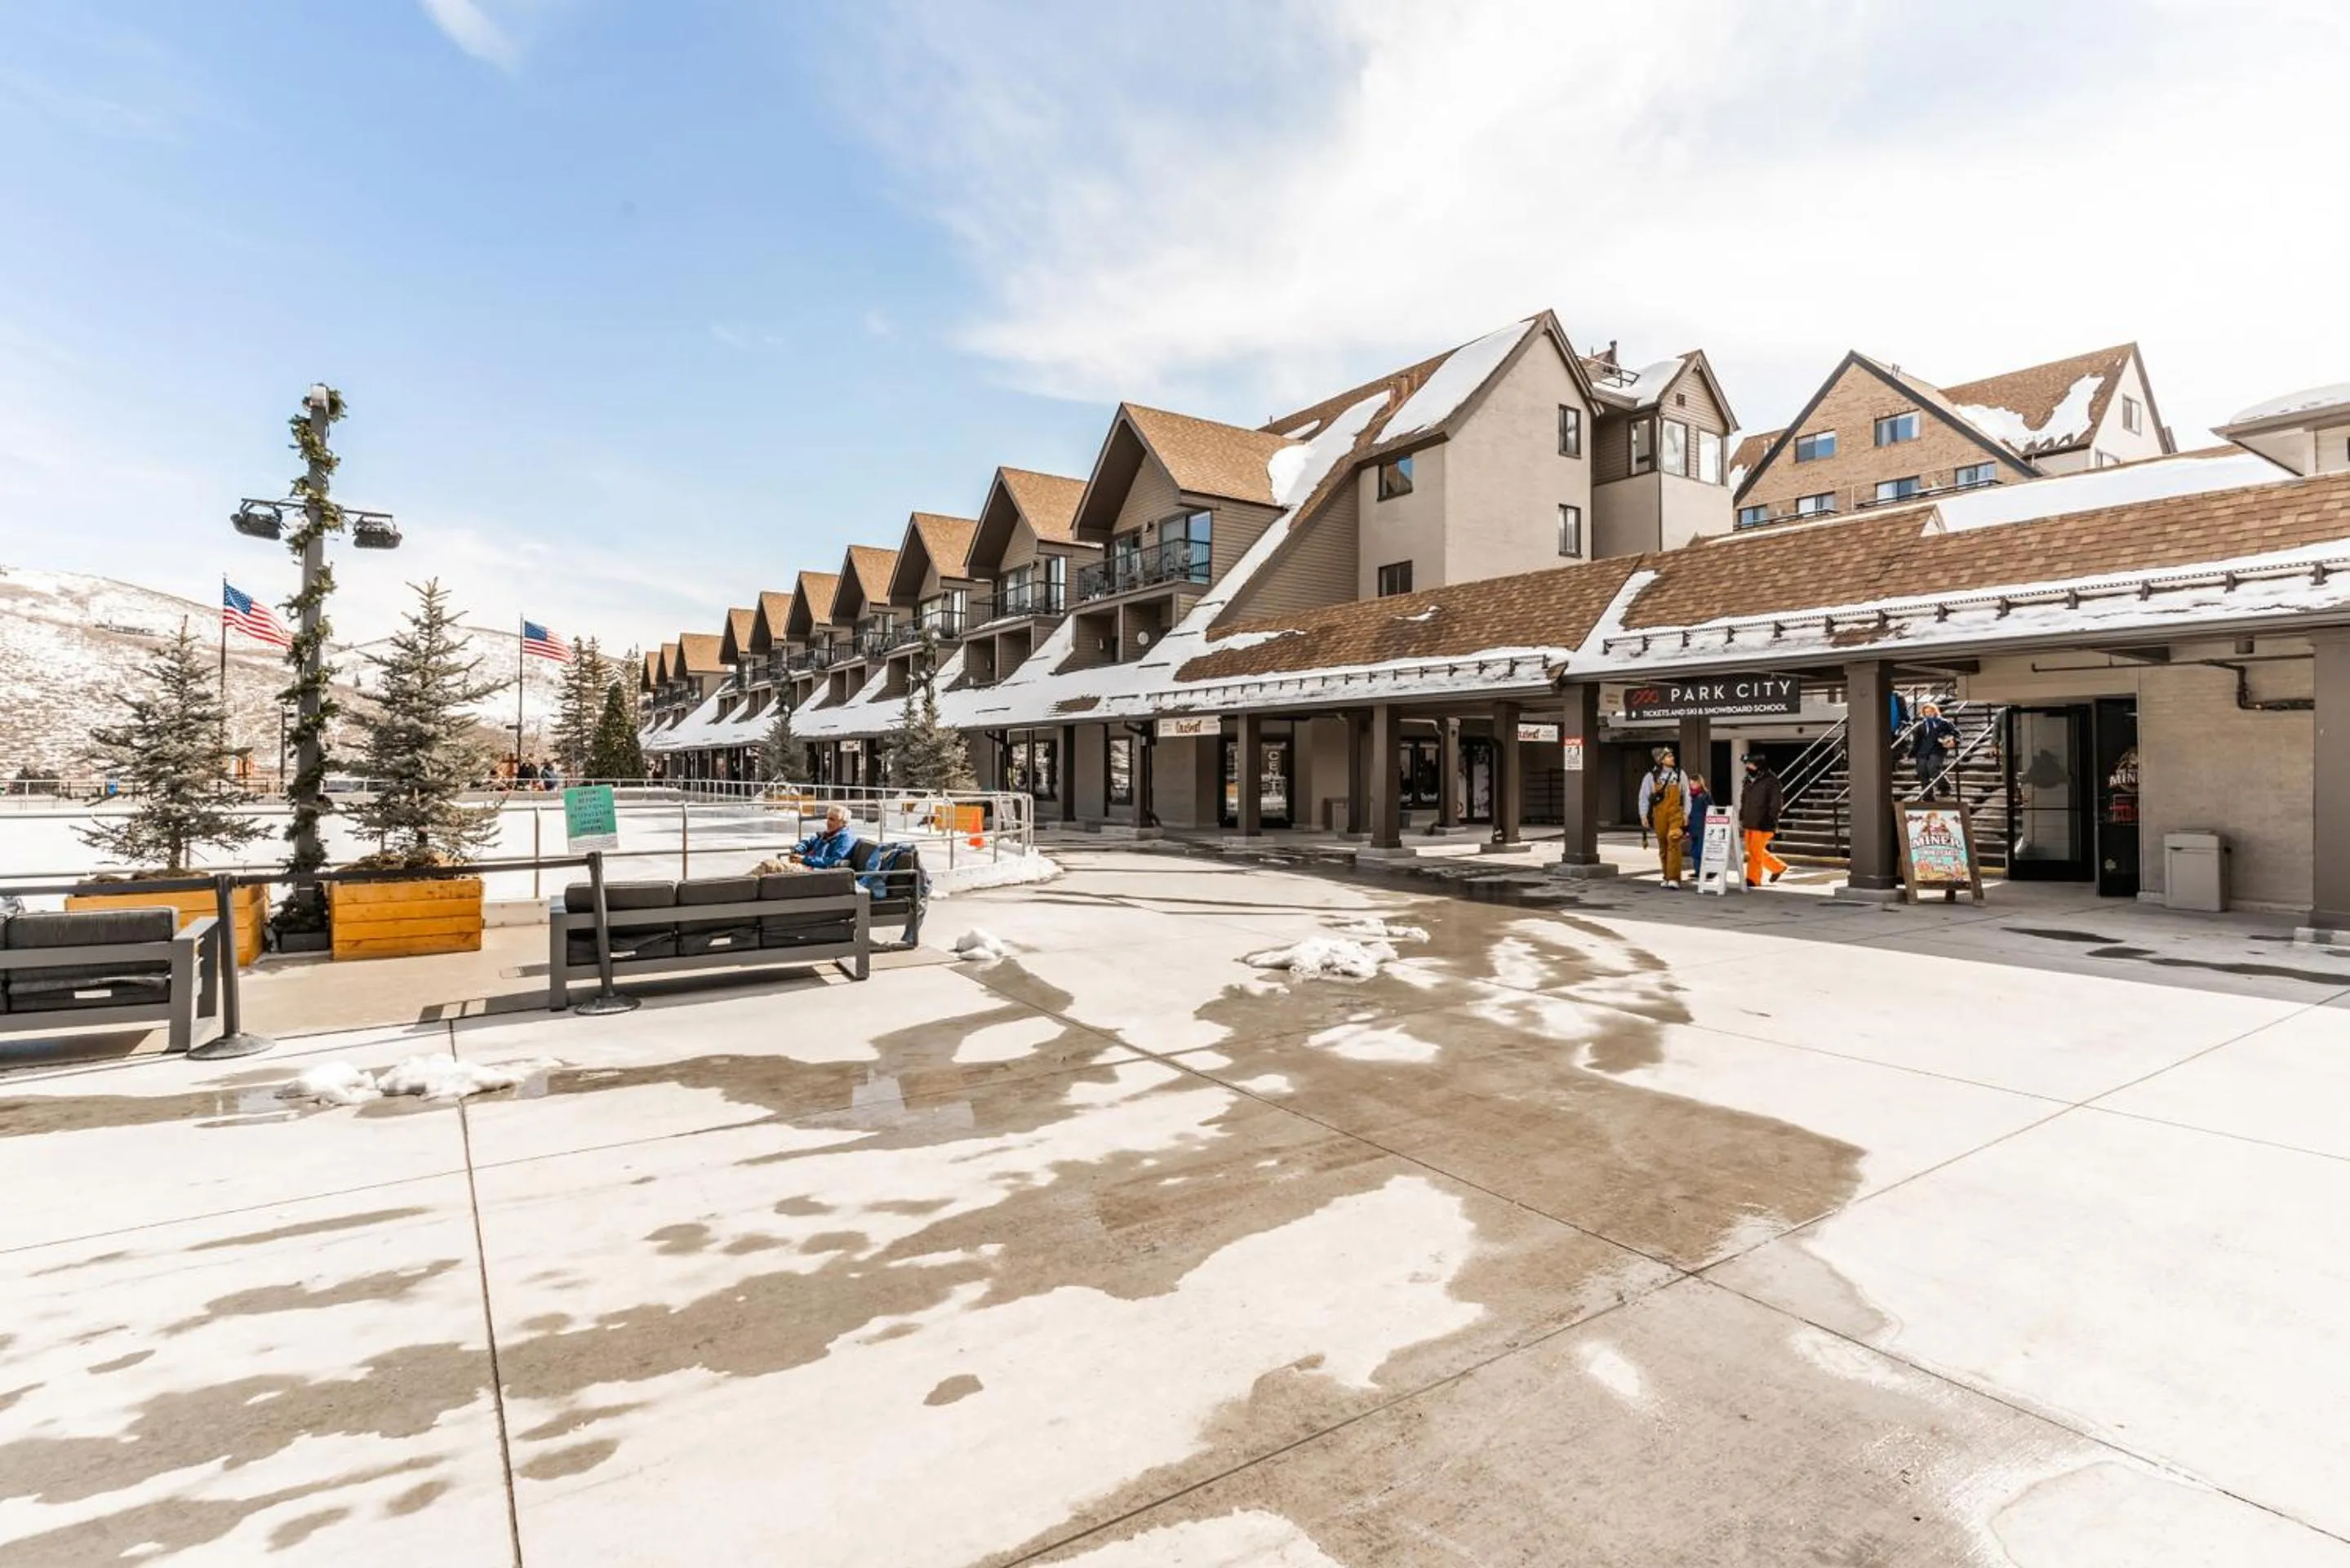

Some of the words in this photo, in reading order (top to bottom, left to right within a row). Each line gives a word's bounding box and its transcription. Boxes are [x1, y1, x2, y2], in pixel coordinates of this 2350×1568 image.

[1670, 685, 1725, 702] PARK
[1736, 680, 1791, 698] CITY
[1642, 708, 1669, 717] TICKETS
[1671, 708, 1686, 717] AND
[1686, 707, 1697, 715] SKI
[1704, 704, 1753, 714] SNOWBOARD
[1754, 703, 1788, 713] SCHOOL
[2108, 768, 2139, 787] MIN
[1910, 834, 1963, 850] MINER
